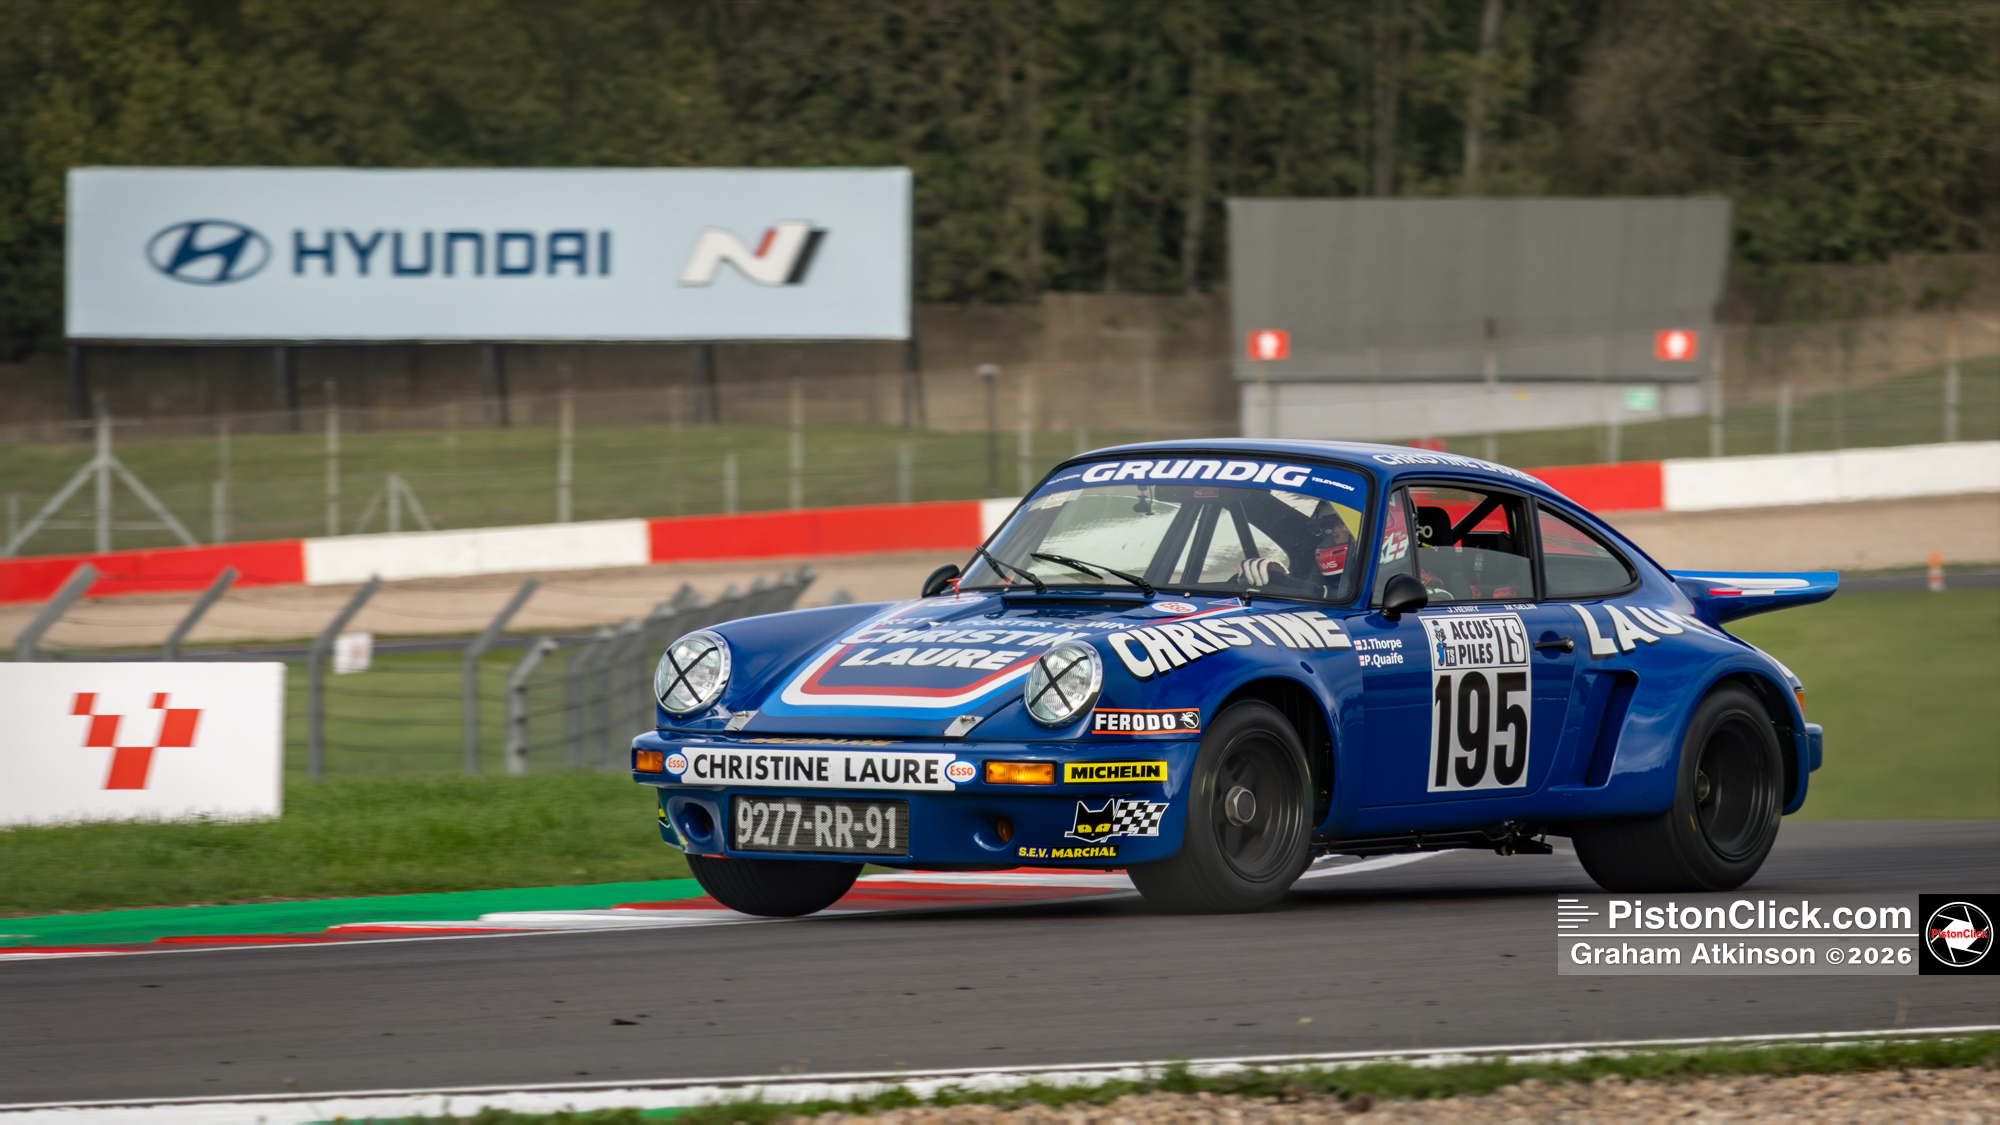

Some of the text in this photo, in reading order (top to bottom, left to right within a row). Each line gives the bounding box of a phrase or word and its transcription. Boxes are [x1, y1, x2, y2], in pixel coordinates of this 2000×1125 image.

[292, 230, 612, 278] HYUNDAI
[1372, 453, 1479, 470] CHRISTINE
[1082, 460, 1312, 488] GRUNDIG
[1311, 476, 1355, 492] TELEVISION
[1449, 619, 1493, 640] ACCUS
[1107, 611, 1352, 678] CHRISTINE
[1361, 638, 1403, 651] J.Thorpe
[1491, 618, 1526, 663] TS
[840, 647, 1028, 671] LAURE
[1364, 652, 1404, 668] P.Quaife
[1458, 642, 1494, 665] PILES
[1095, 713, 1176, 731] FERODO
[1434, 671, 1529, 789] 195
[667, 756, 685, 770] Esso
[693, 753, 939, 785] CHRISTINE LAURE
[950, 764, 974, 776] Esso
[1071, 765, 1161, 780] MICHELIN
[737, 802, 898, 850] 9277-RR-91
[1018, 846, 1117, 859] S.E.V. MARCHAL
